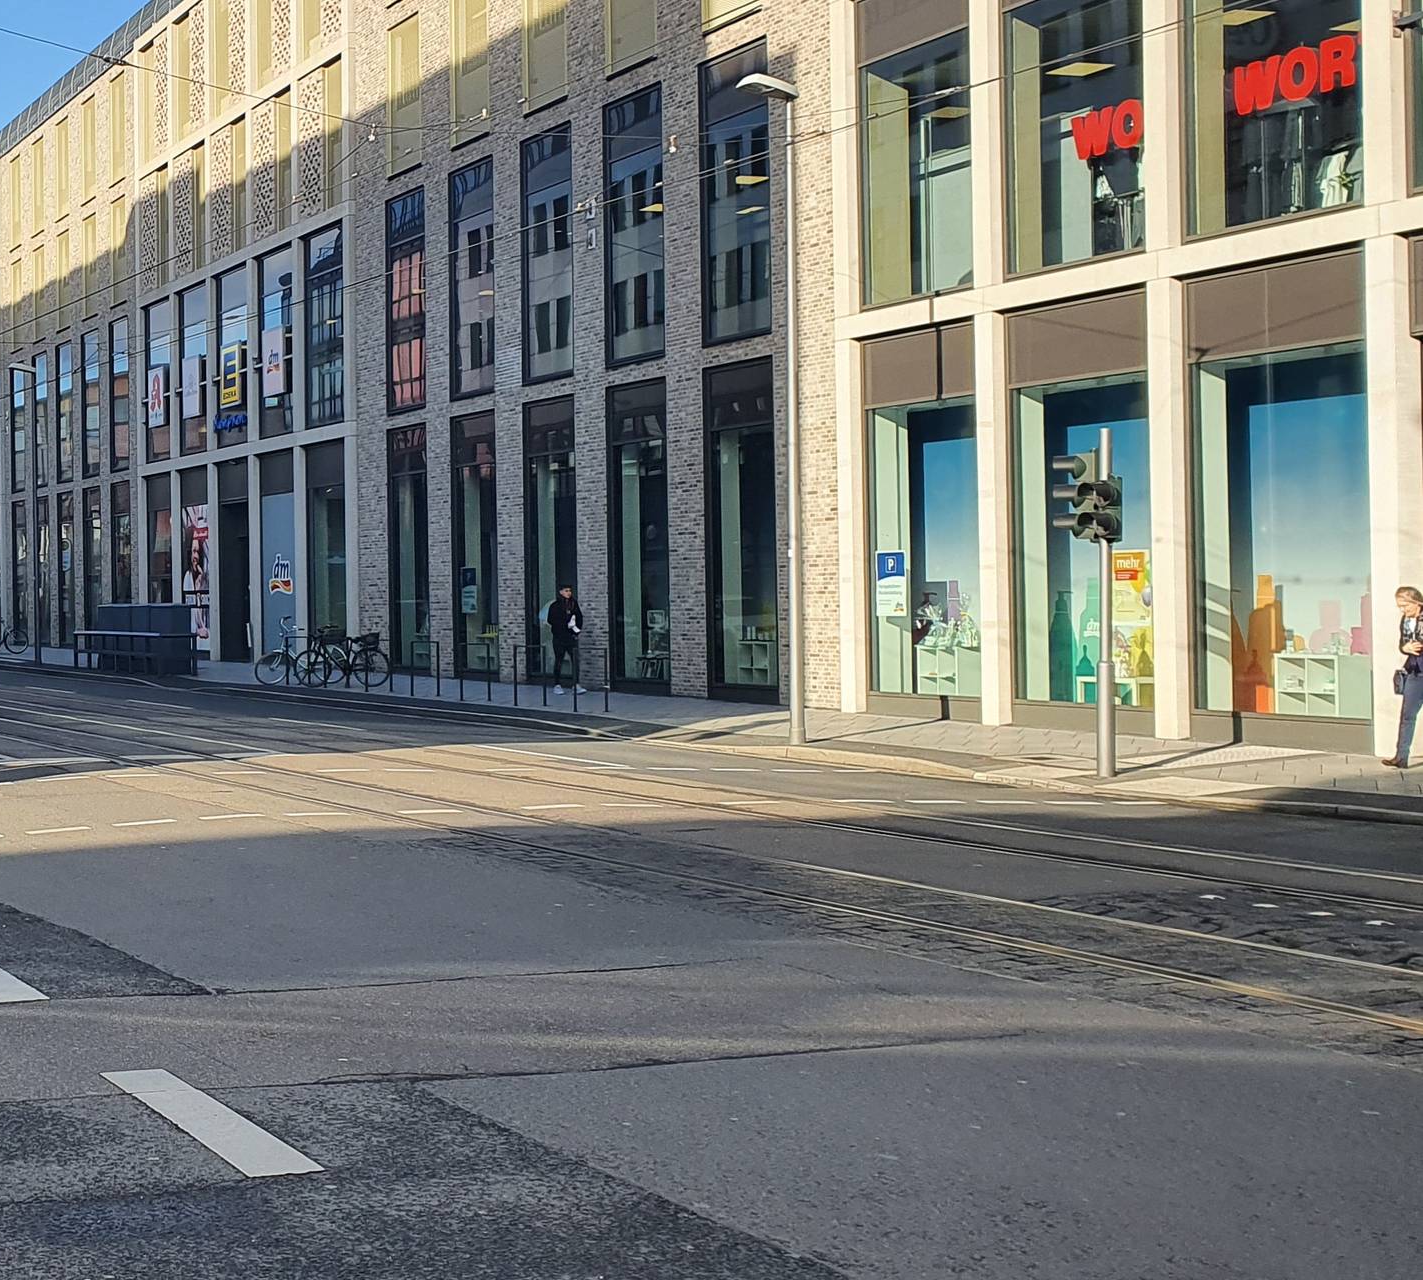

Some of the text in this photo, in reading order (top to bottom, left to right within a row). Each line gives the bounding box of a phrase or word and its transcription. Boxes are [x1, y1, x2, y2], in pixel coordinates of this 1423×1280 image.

[1233, 32, 1361, 116] WOR
[268, 348, 279, 365] dm
[273, 554, 290, 579] dm
[887, 558, 895, 571] P
[1116, 557, 1141, 569] mehr
